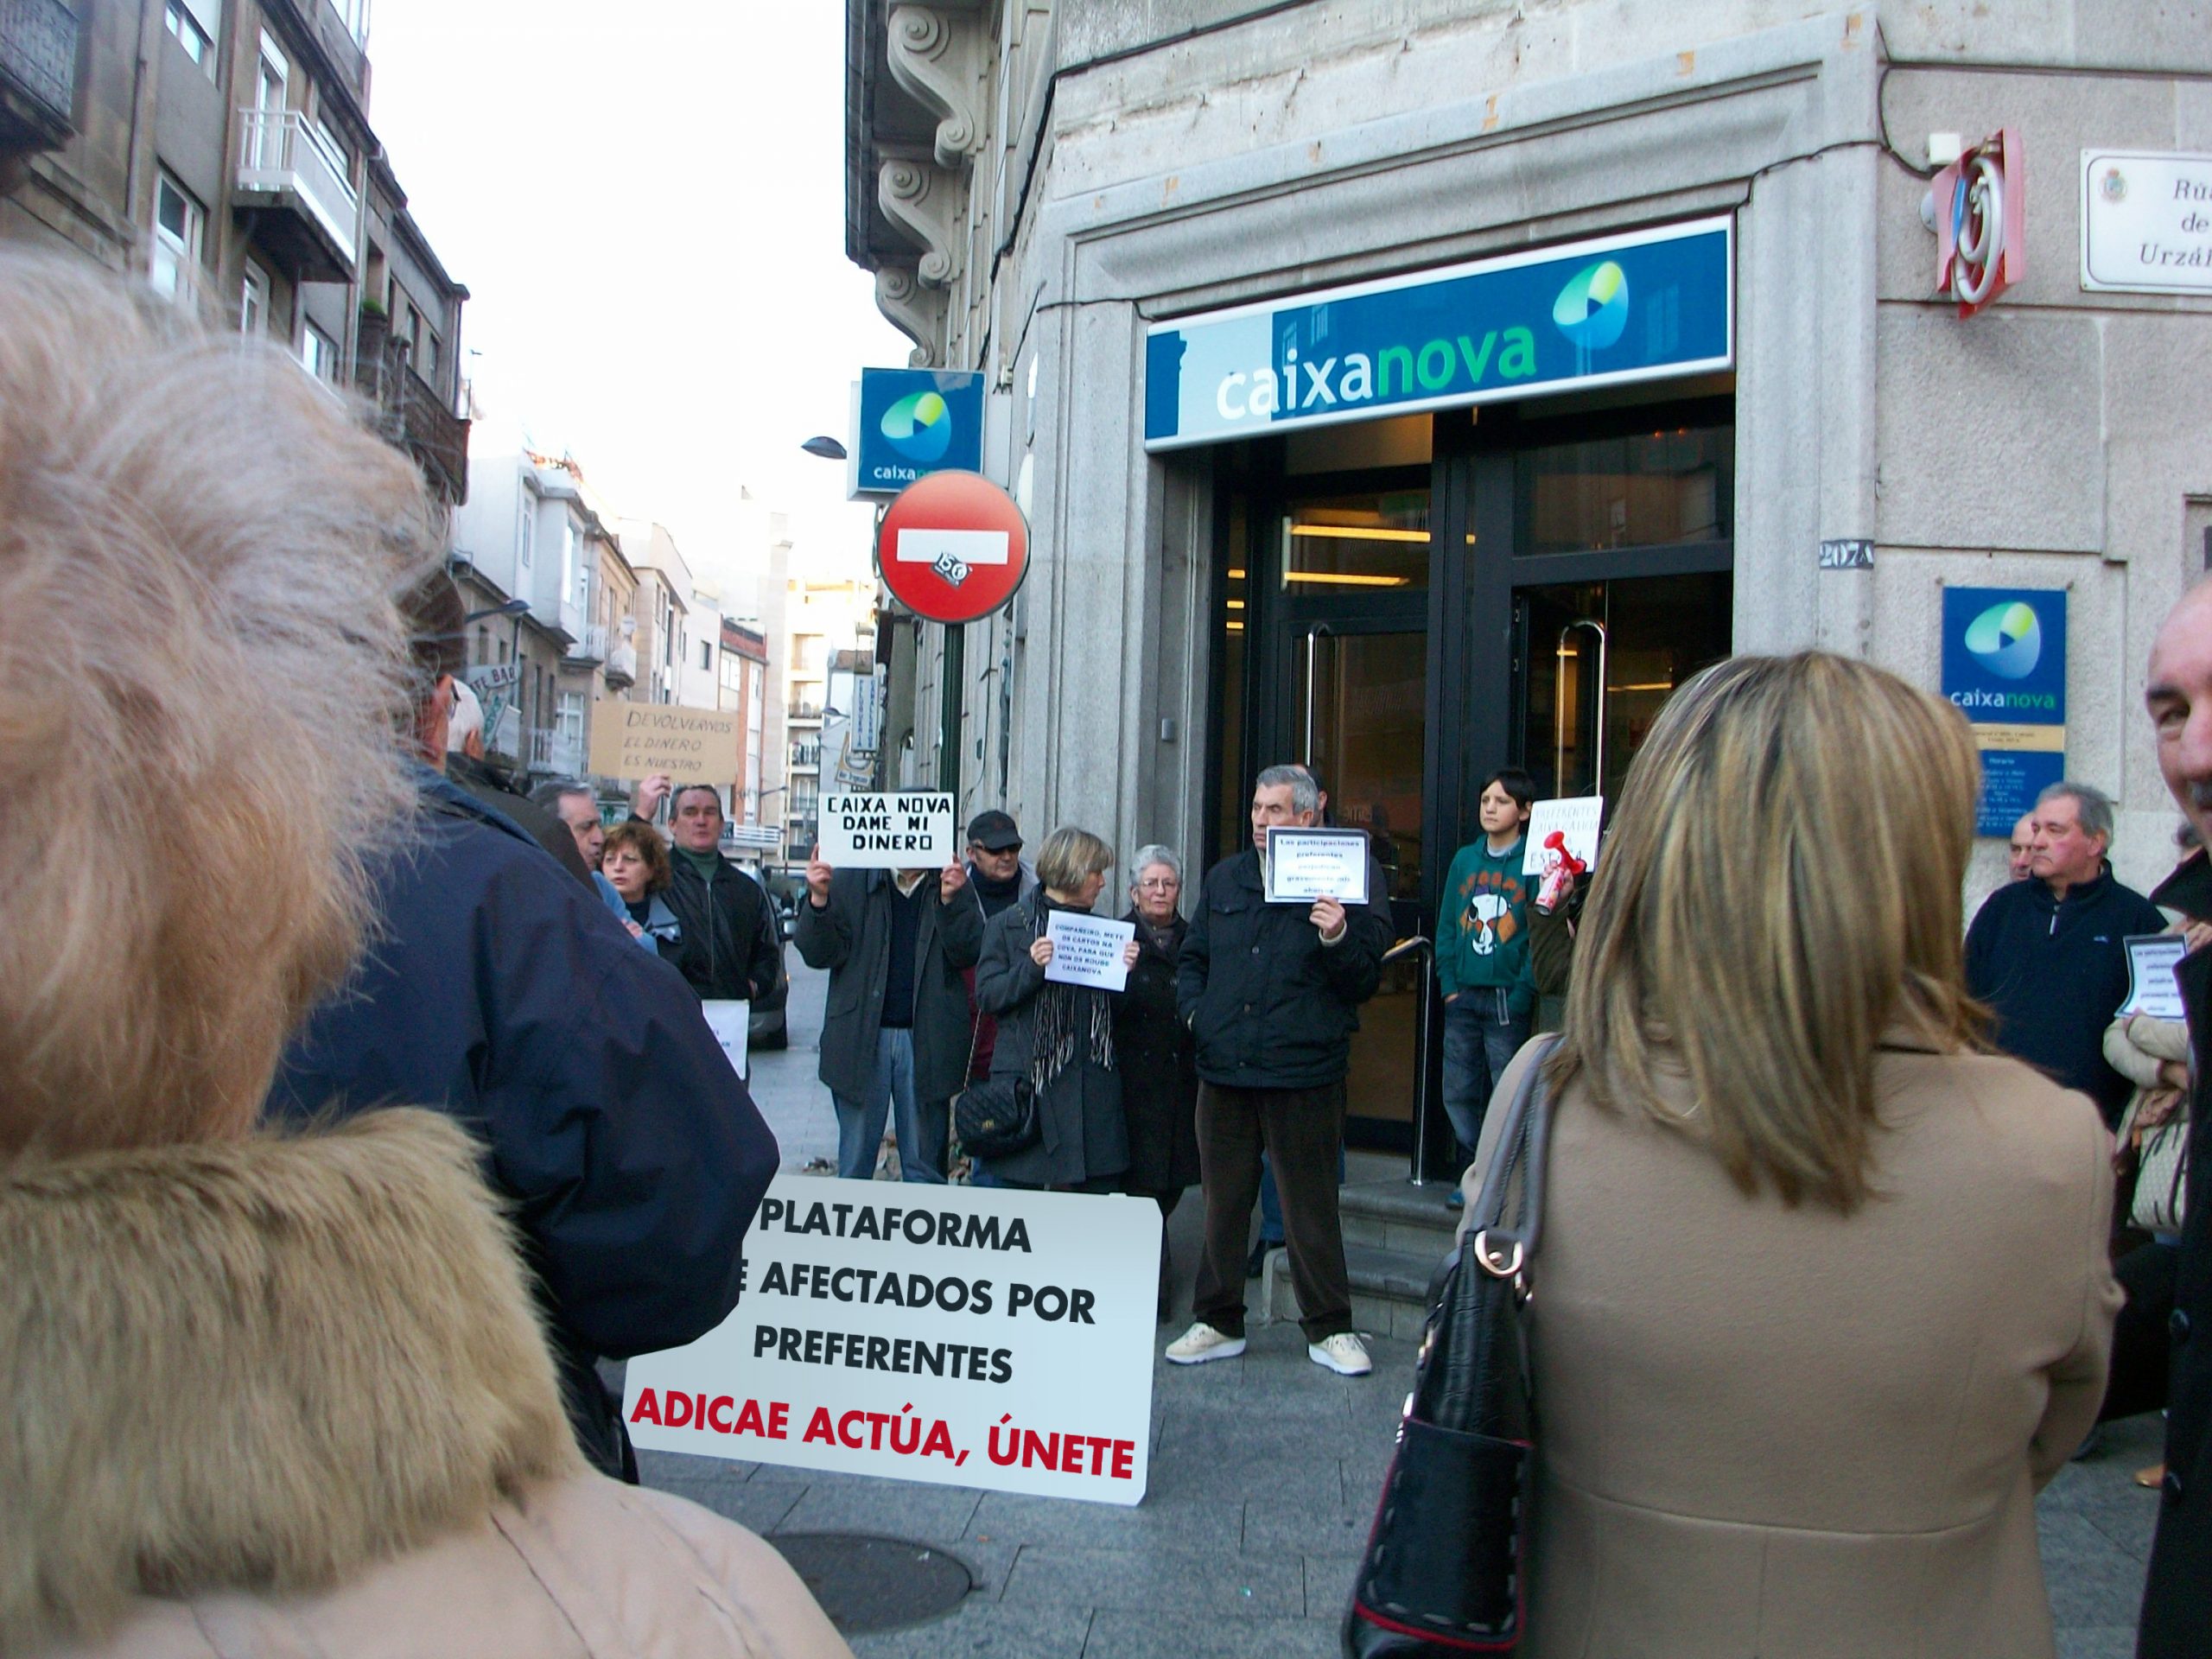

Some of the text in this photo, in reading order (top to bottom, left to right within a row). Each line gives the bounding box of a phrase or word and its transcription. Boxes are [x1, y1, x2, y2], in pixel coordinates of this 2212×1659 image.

[2174, 178, 2212, 200] Rú
[2181, 212, 2209, 232] de
[2140, 242, 2212, 267] Urzái
[1217, 325, 1537, 420] caixanova
[1819, 542, 1873, 567] 207A
[1950, 688, 2056, 709] caixanova
[645, 737, 702, 752] DINERO
[624, 755, 702, 772] ES NUESTRO
[828, 797, 950, 813] CAIXA NOVA
[843, 816, 928, 831] DAME MI
[853, 835, 932, 850] DINERO
[1297, 838, 1360, 848] participaciones
[1072, 936, 1100, 946] CARTOS
[1104, 931, 1124, 941] METE
[1078, 947, 1096, 956] PARA
[1062, 963, 1102, 976] CAIXANOVA
[760, 1198, 1033, 1253] PLATAFORMA
[760, 1261, 993, 1316] AFECTADOS
[1007, 1283, 1096, 1325] POR
[753, 1325, 1014, 1384] PREFERENTES
[630, 1387, 1135, 1479] ADICAE ACTÚA, ÚNETE
